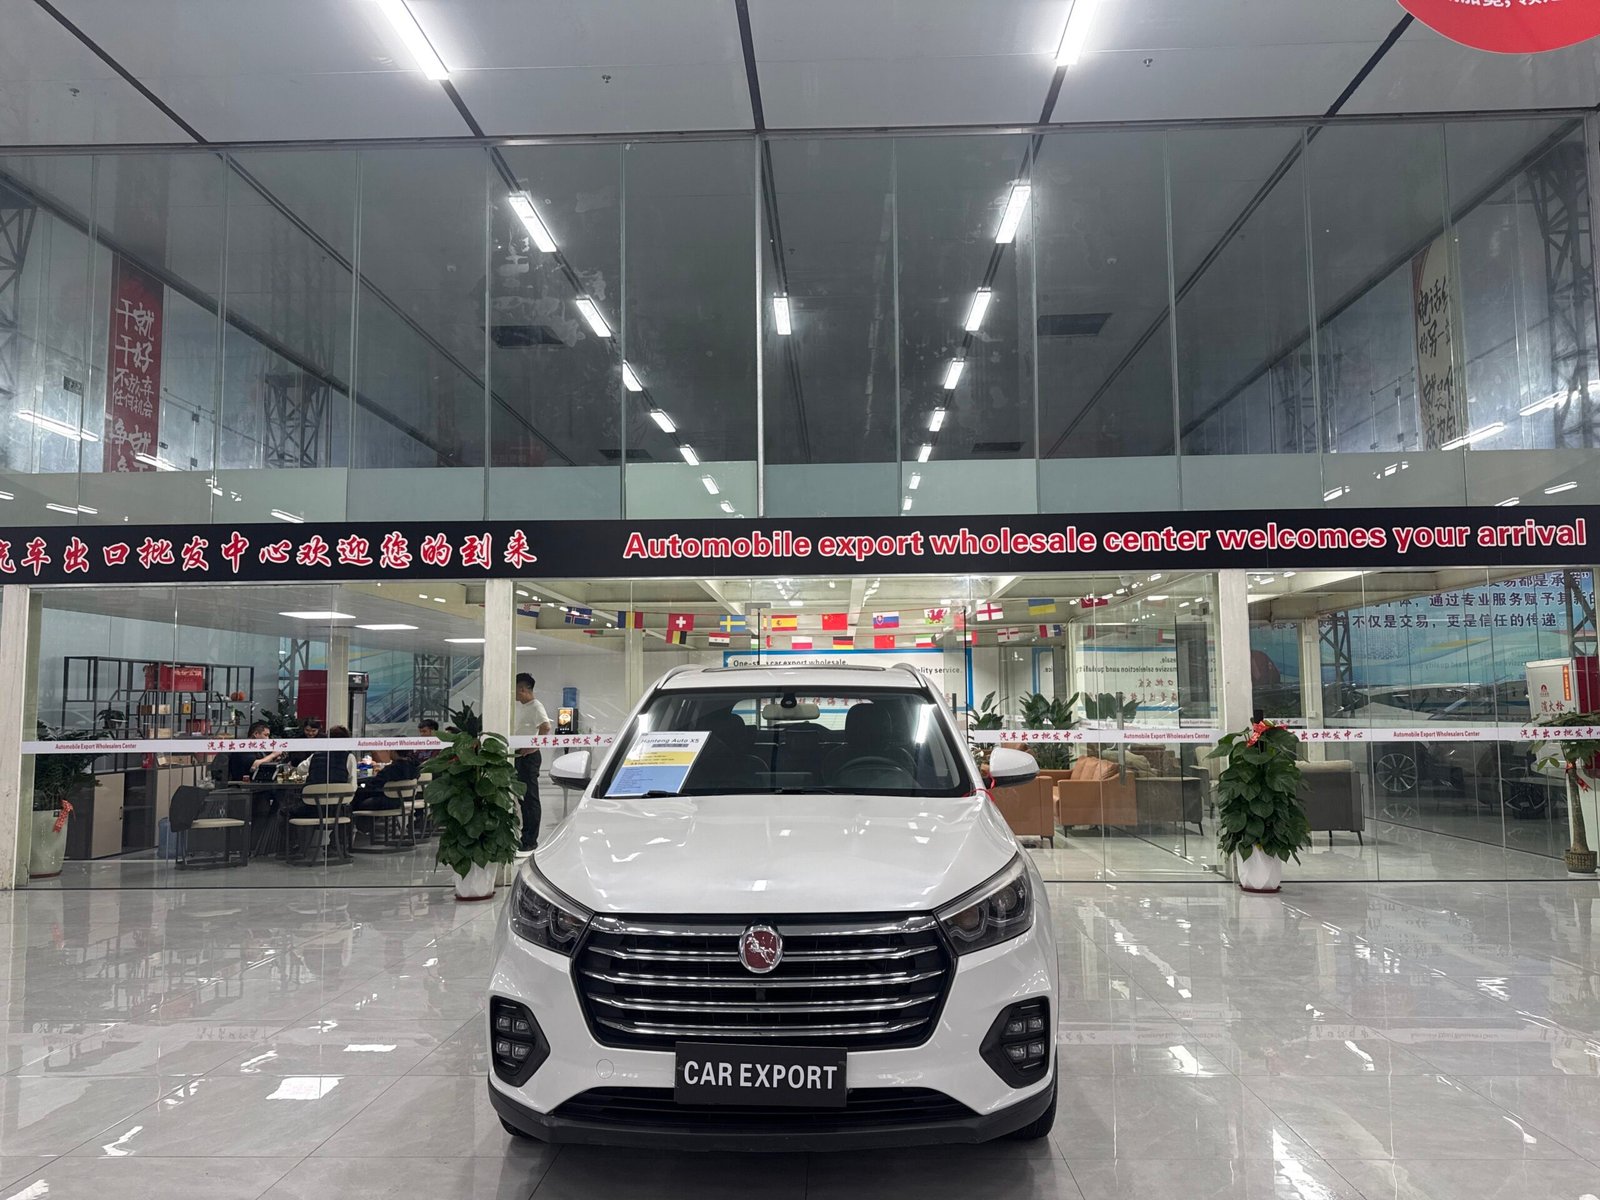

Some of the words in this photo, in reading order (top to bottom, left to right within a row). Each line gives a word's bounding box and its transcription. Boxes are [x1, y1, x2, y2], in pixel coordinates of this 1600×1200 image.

[623, 530, 812, 560] Automobile
[818, 529, 924, 562] export
[930, 526, 1097, 556] wholesale
[1103, 526, 1210, 552] center
[1216, 522, 1387, 551] welcomes
[1393, 526, 1470, 554] your
[1477, 518, 1587, 547] arrival
[999, 731, 1084, 742] 汽车出口批发中心
[1123, 732, 1150, 741] Automobile
[1150, 732, 1166, 741] Export
[1166, 732, 1194, 741] Wholesalers
[1194, 732, 1210, 741] Center
[1393, 730, 1420, 739] Automobile
[1420, 730, 1436, 739] Export
[1436, 730, 1464, 739] Wholesalers
[1464, 730, 1480, 739] Center
[55, 743, 80, 751] Automobile
[80, 743, 95, 751] Export
[95, 743, 122, 751] Wholesalers
[122, 743, 137, 751] Center
[207, 740, 289, 751] 汽车出口批发中心
[357, 739, 384, 748] Automobile
[383, 739, 399, 748] Export
[399, 739, 426, 748] Wholesalers
[426, 739, 441, 748] Center
[531, 736, 613, 747] 汽车出口批发中心
[683, 1060, 733, 1087] CAR
[739, 1063, 838, 1090] EXPORT
